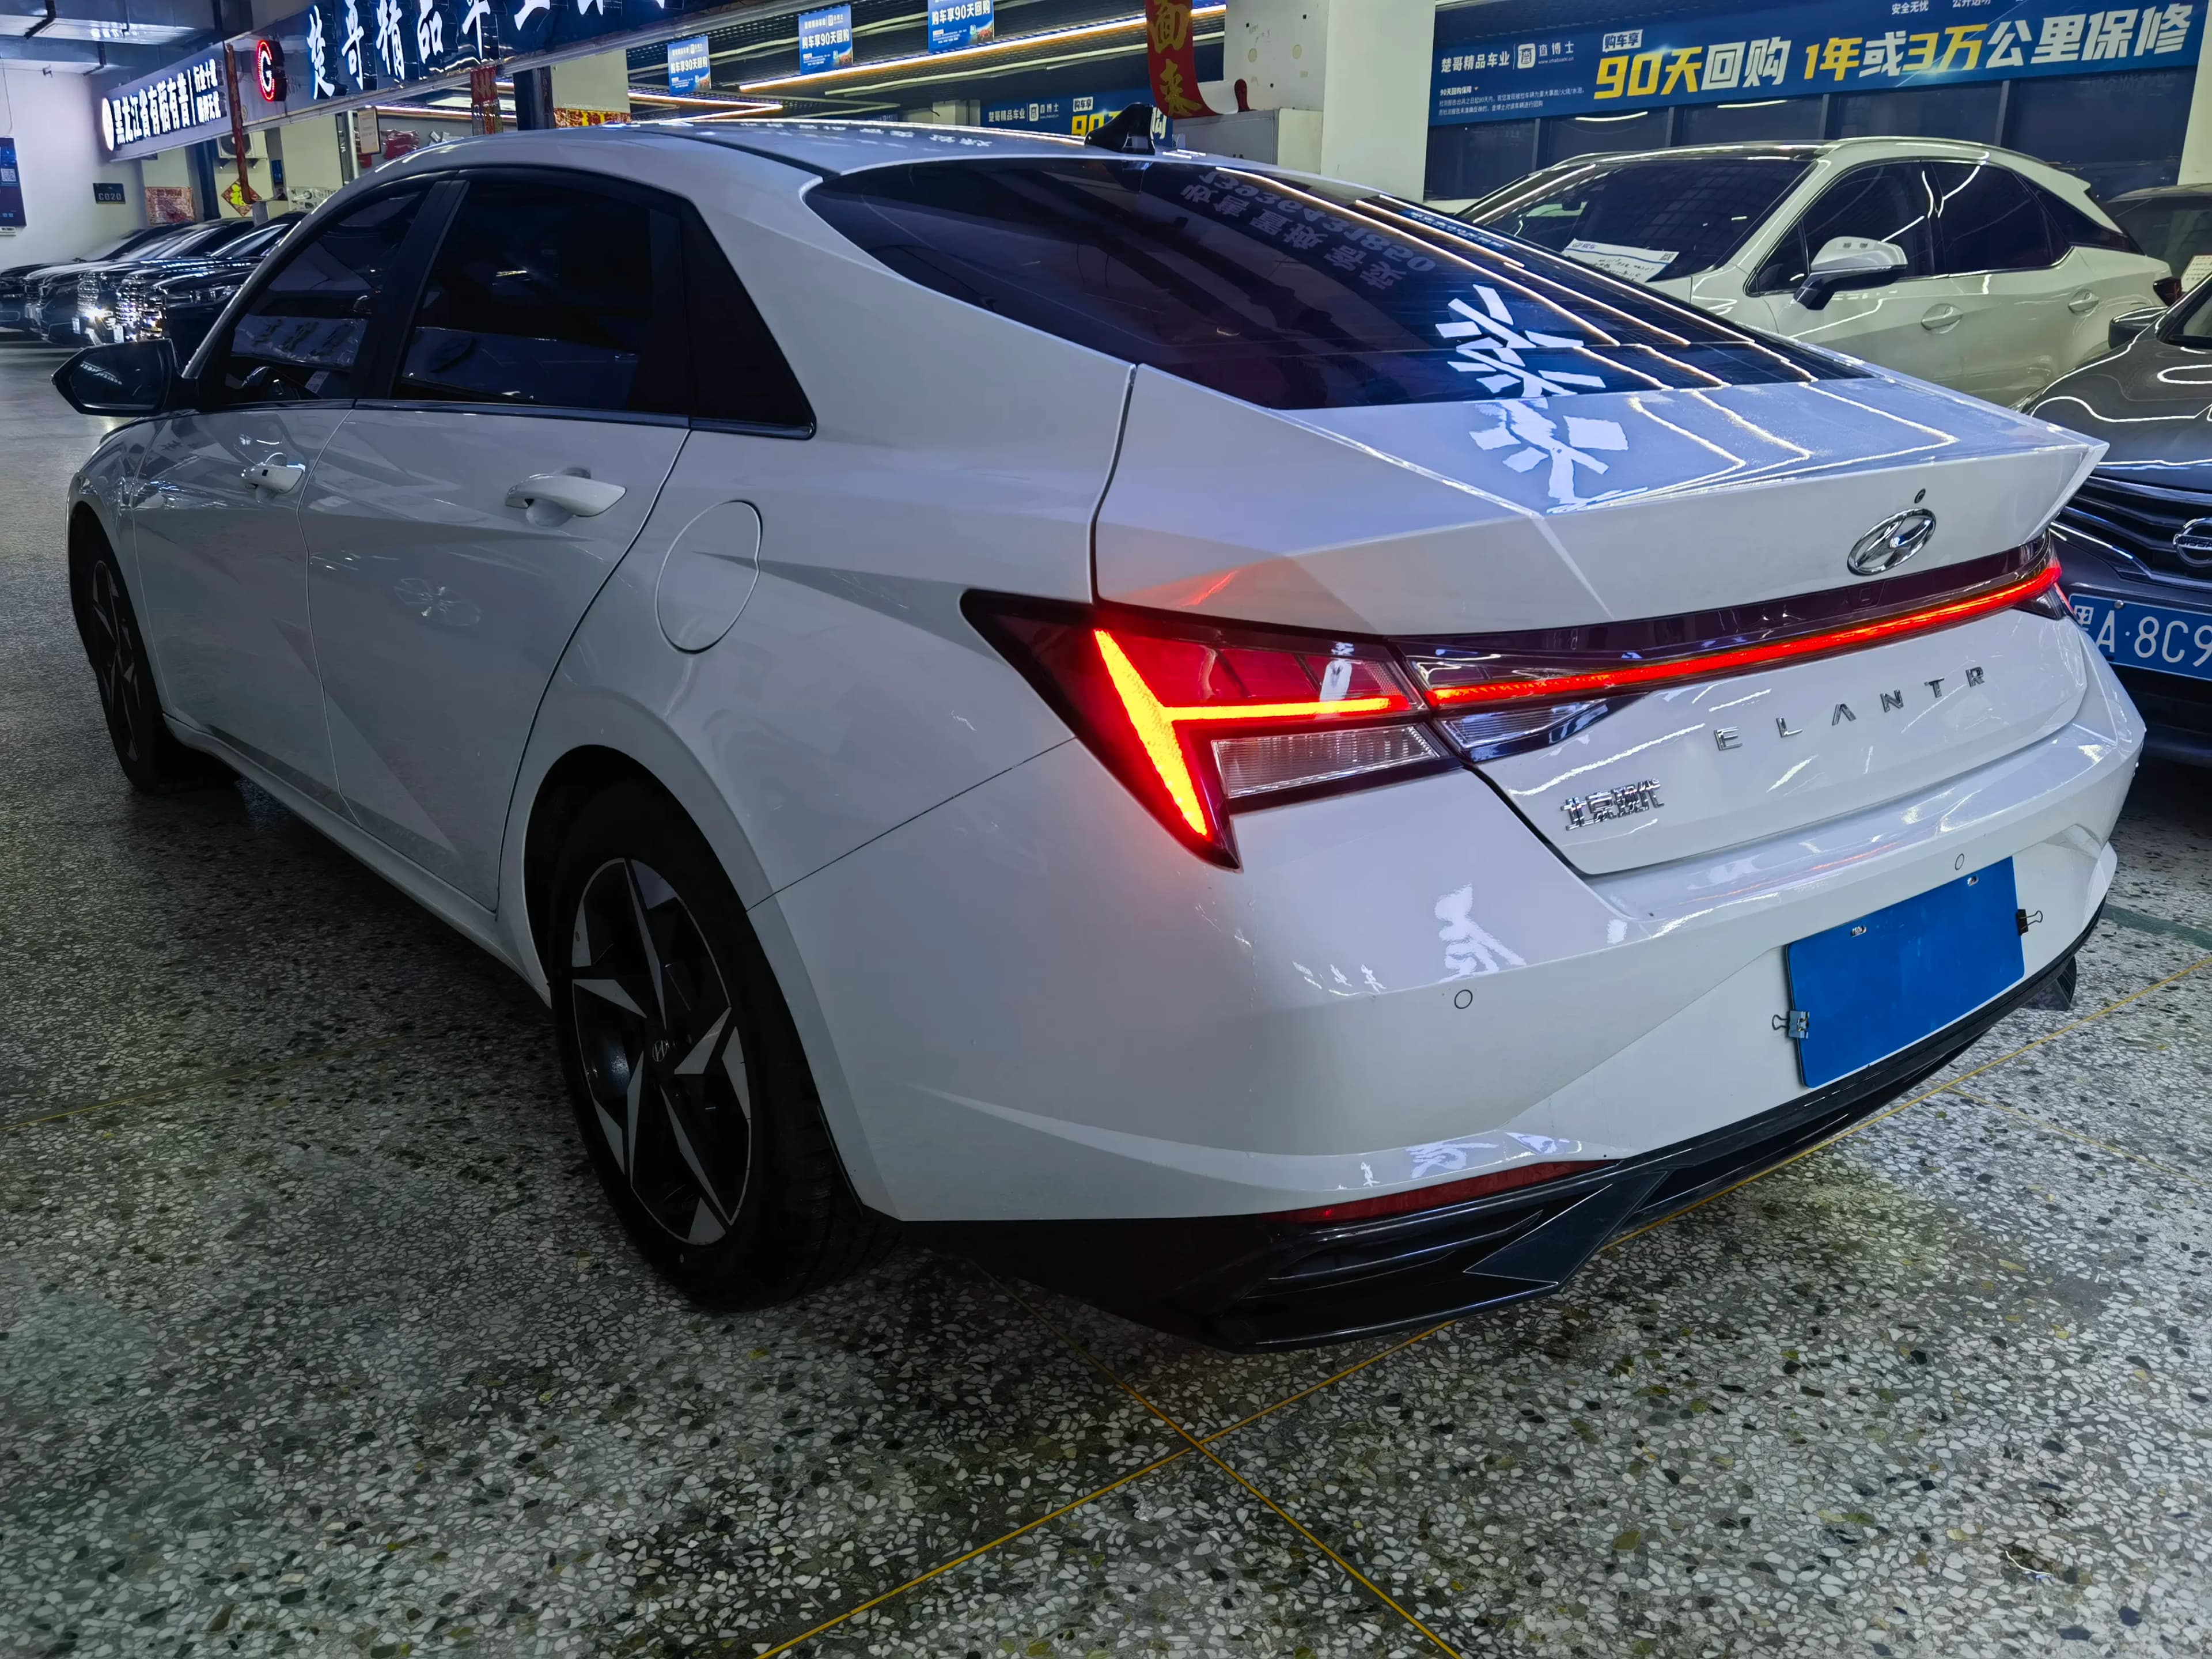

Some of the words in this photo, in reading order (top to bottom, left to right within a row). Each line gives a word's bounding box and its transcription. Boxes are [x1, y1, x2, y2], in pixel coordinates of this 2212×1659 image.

[932, 1, 990, 25] 购车享90天回购
[1892, 1, 1929, 15] 安全无忧
[1605, 31, 1639, 49] 购车享
[1804, 3, 2192, 81] 1年或3万公里保修
[1441, 51, 1510, 73] 楚哥精品车业
[1594, 36, 1791, 99] 90天回购
[1560, 778, 1664, 831] 北京现代
